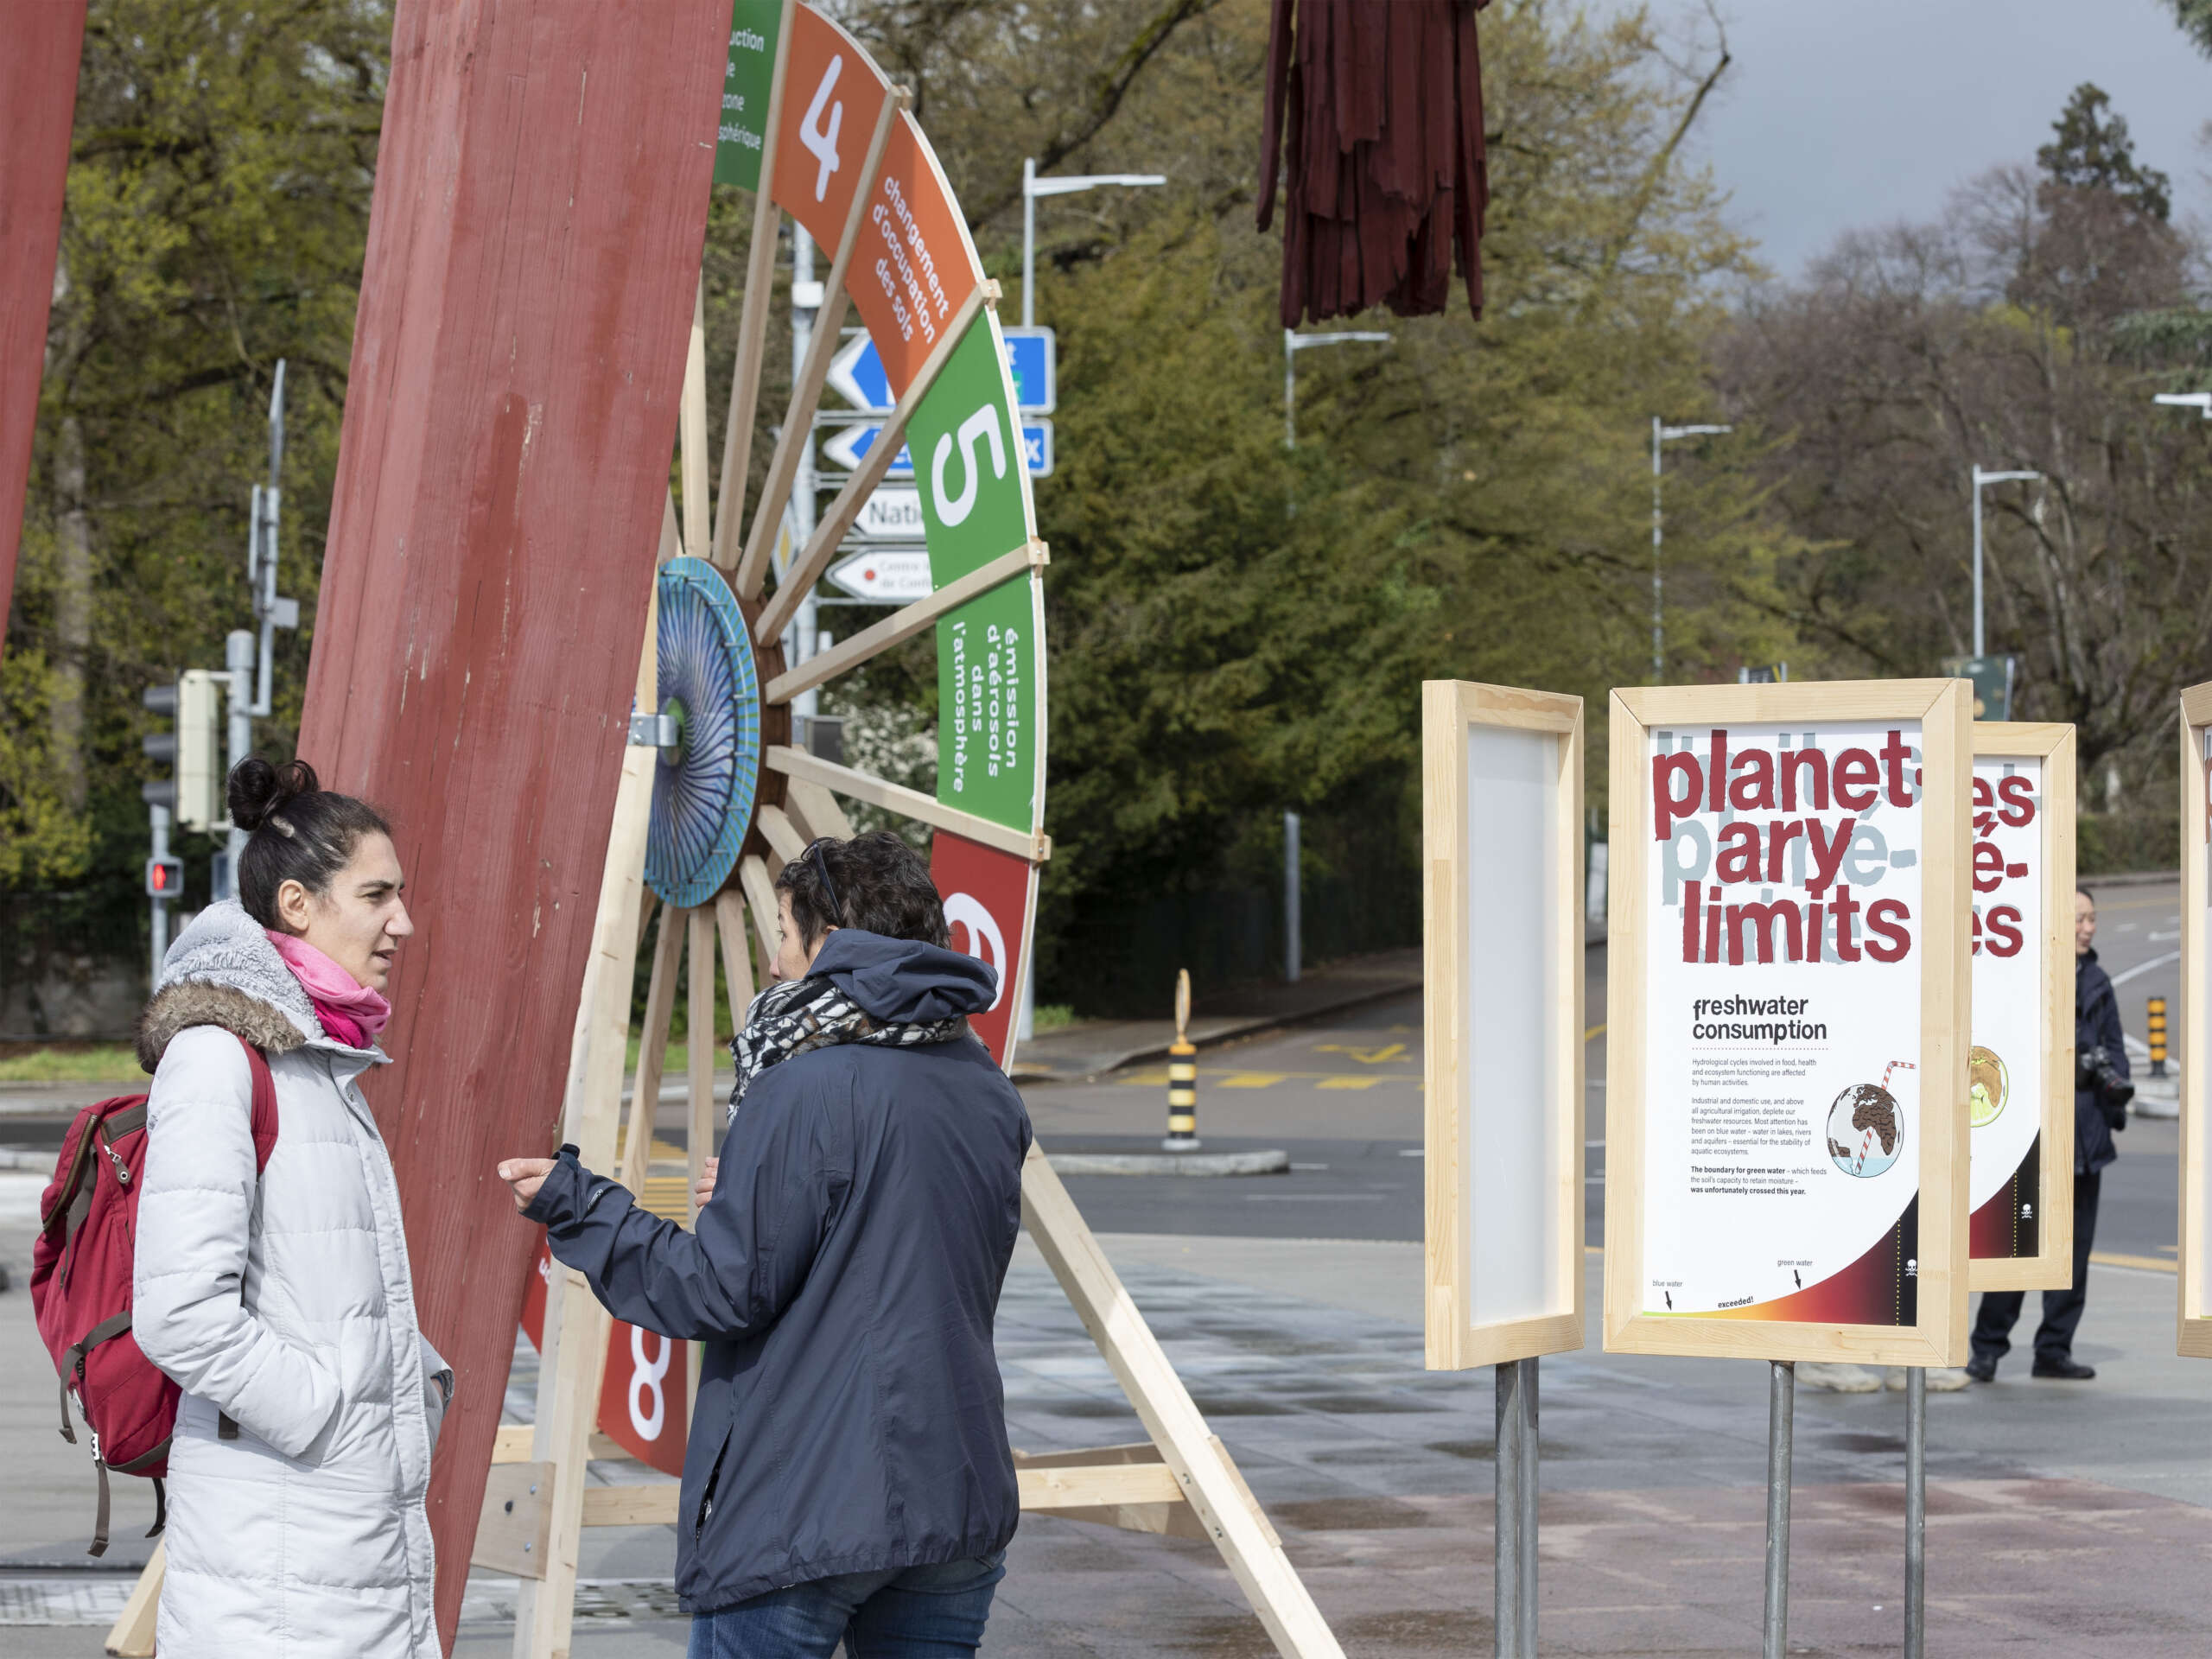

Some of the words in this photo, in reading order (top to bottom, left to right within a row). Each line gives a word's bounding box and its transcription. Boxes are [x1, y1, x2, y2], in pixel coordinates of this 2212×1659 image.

[799, 54, 843, 203] 4
[872, 203, 936, 345] d'occupation
[884, 175, 950, 320] changement
[875, 257, 896, 298] des
[892, 295, 913, 342] sols
[931, 403, 1007, 527] 5
[870, 502, 922, 524] Nati
[952, 621, 968, 792] l'atmosphère
[971, 664, 984, 732] dans
[987, 624, 1002, 778] d'aérosols
[1005, 627, 1019, 768] émission
[1652, 729, 1923, 842] planet
[1715, 818, 1857, 892] ary
[1682, 880, 1911, 965] limits
[1693, 994, 1808, 1020] freshwater
[1693, 1020, 1827, 1046] consumption
[1692, 1058, 1728, 1067] Hydrological
[1704, 1069, 1736, 1077] ecosystem
[1737, 1069, 1770, 1077] functioning
[1700, 1108, 1732, 1116] agricultural
[1733, 1108, 1761, 1116] irrigation,
[1780, 1139, 1802, 1147] stability
[1704, 1166, 1734, 1175] boundary
[1705, 1186, 1748, 1195] unfortunately
[1777, 1259, 1795, 1268] green
[1718, 1296, 1754, 1308] exceeded!
